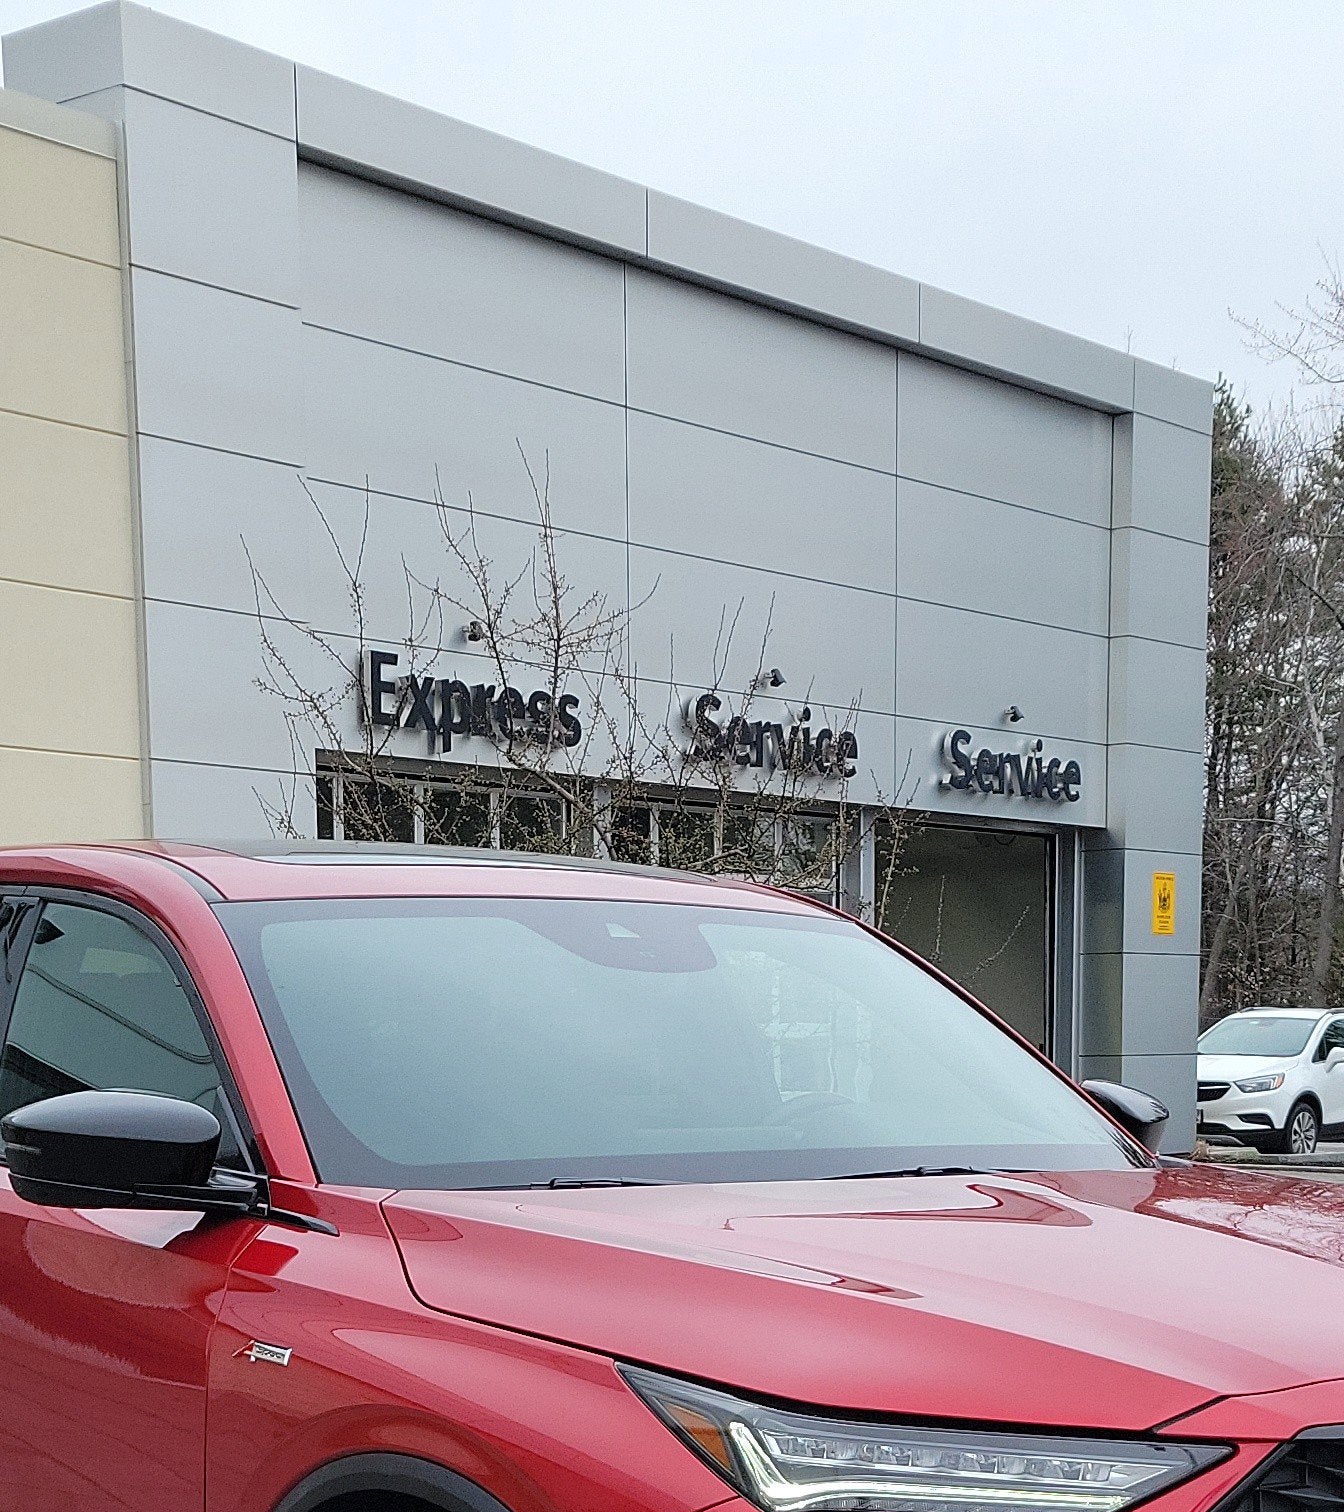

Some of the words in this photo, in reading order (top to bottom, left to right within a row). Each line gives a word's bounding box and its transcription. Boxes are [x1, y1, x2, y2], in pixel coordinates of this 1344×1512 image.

[365, 649, 581, 753] Express
[691, 693, 858, 778] Service
[944, 729, 1083, 802] Service
